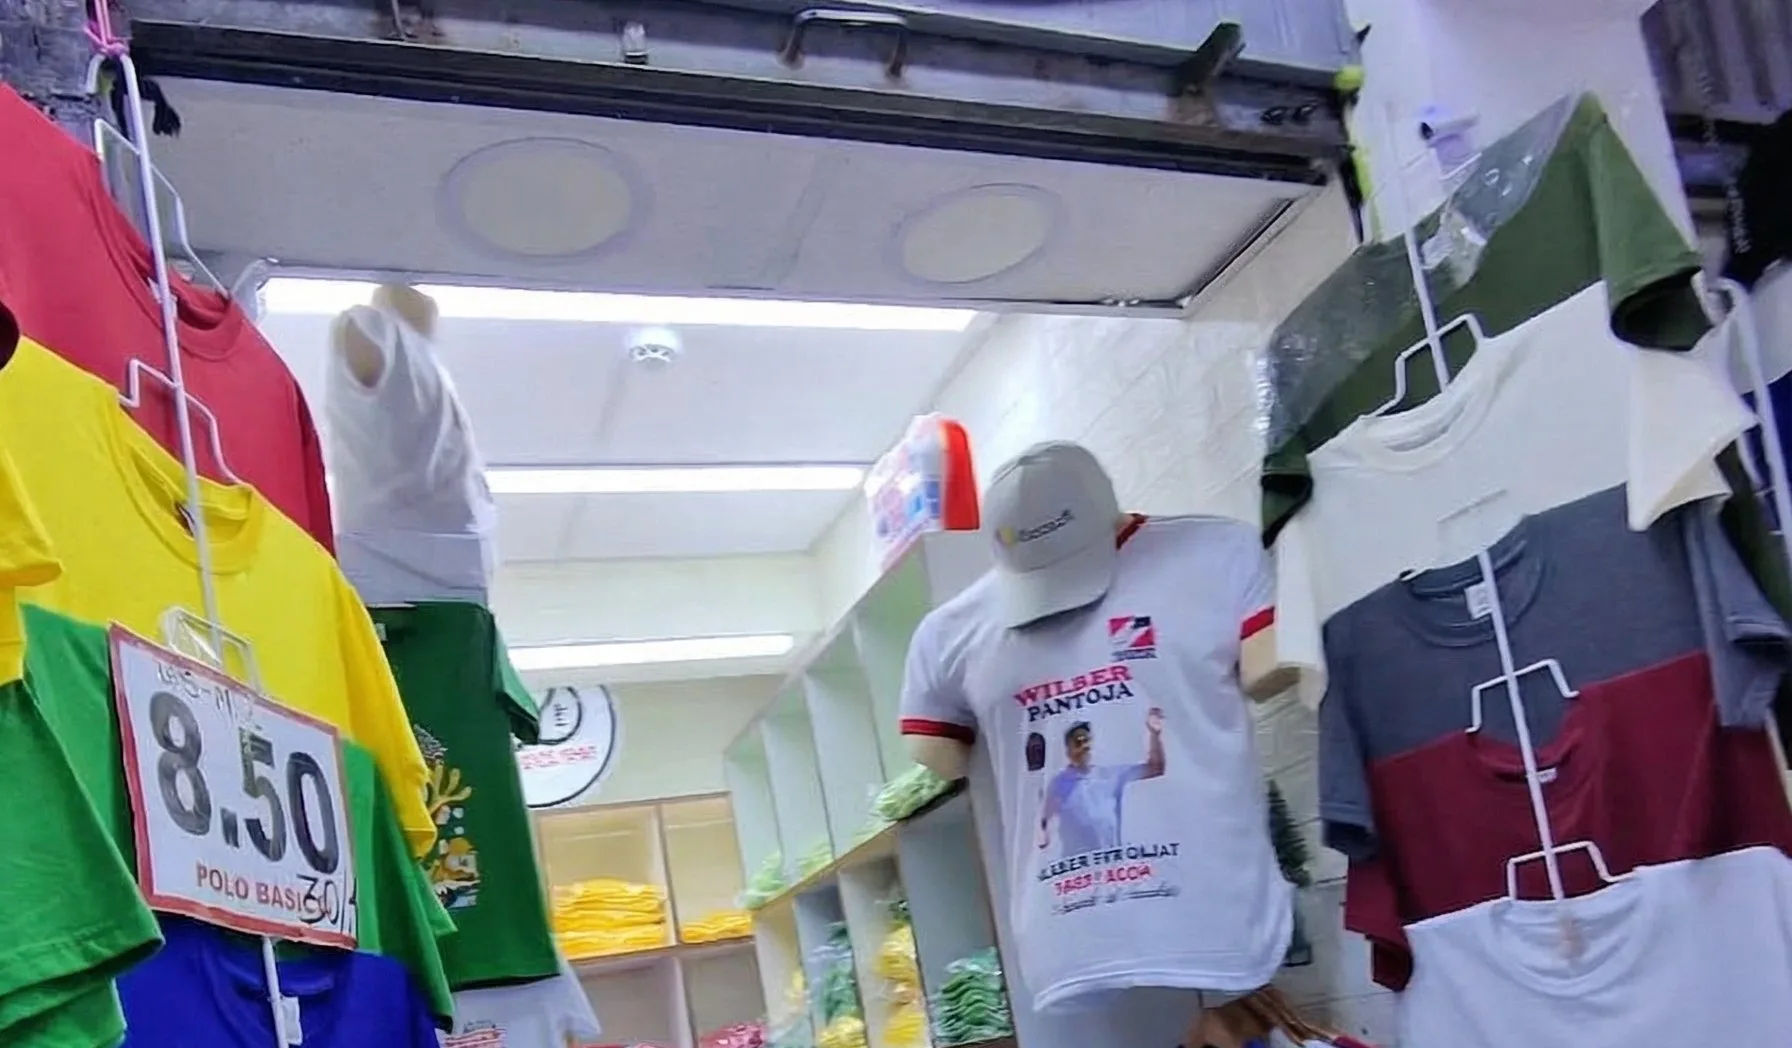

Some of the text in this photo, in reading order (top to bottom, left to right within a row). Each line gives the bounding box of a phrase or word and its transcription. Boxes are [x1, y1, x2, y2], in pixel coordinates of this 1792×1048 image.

[1027, 682, 1134, 722] PANTOJA
[150, 691, 339, 875] 8.50
[196, 863, 249, 900] POLO
